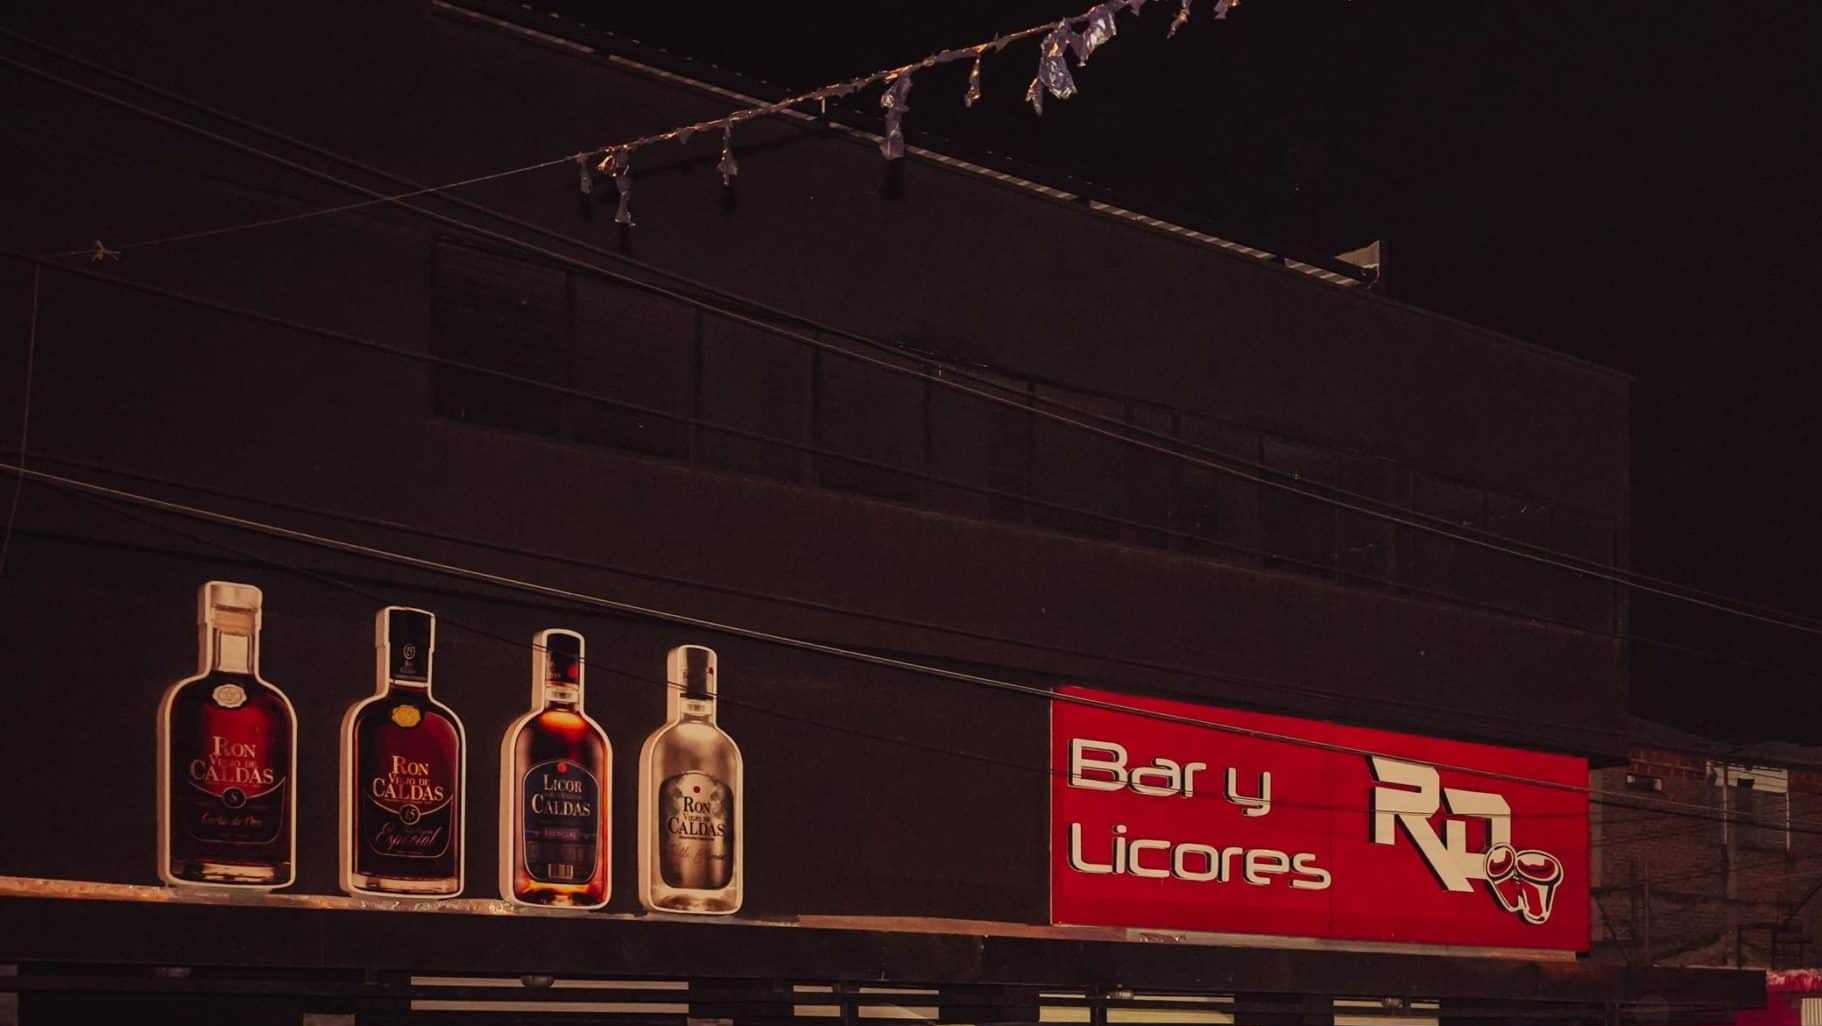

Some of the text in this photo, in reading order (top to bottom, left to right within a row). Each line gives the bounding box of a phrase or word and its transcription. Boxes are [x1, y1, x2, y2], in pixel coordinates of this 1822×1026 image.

[189, 759, 275, 785] CALDAS
[1068, 738, 1271, 817] Bar y
[372, 777, 444, 801] CALDAS
[531, 793, 592, 817] CALDAS
[668, 816, 726, 837] CALDAS
[1068, 822, 1333, 891] Licores
